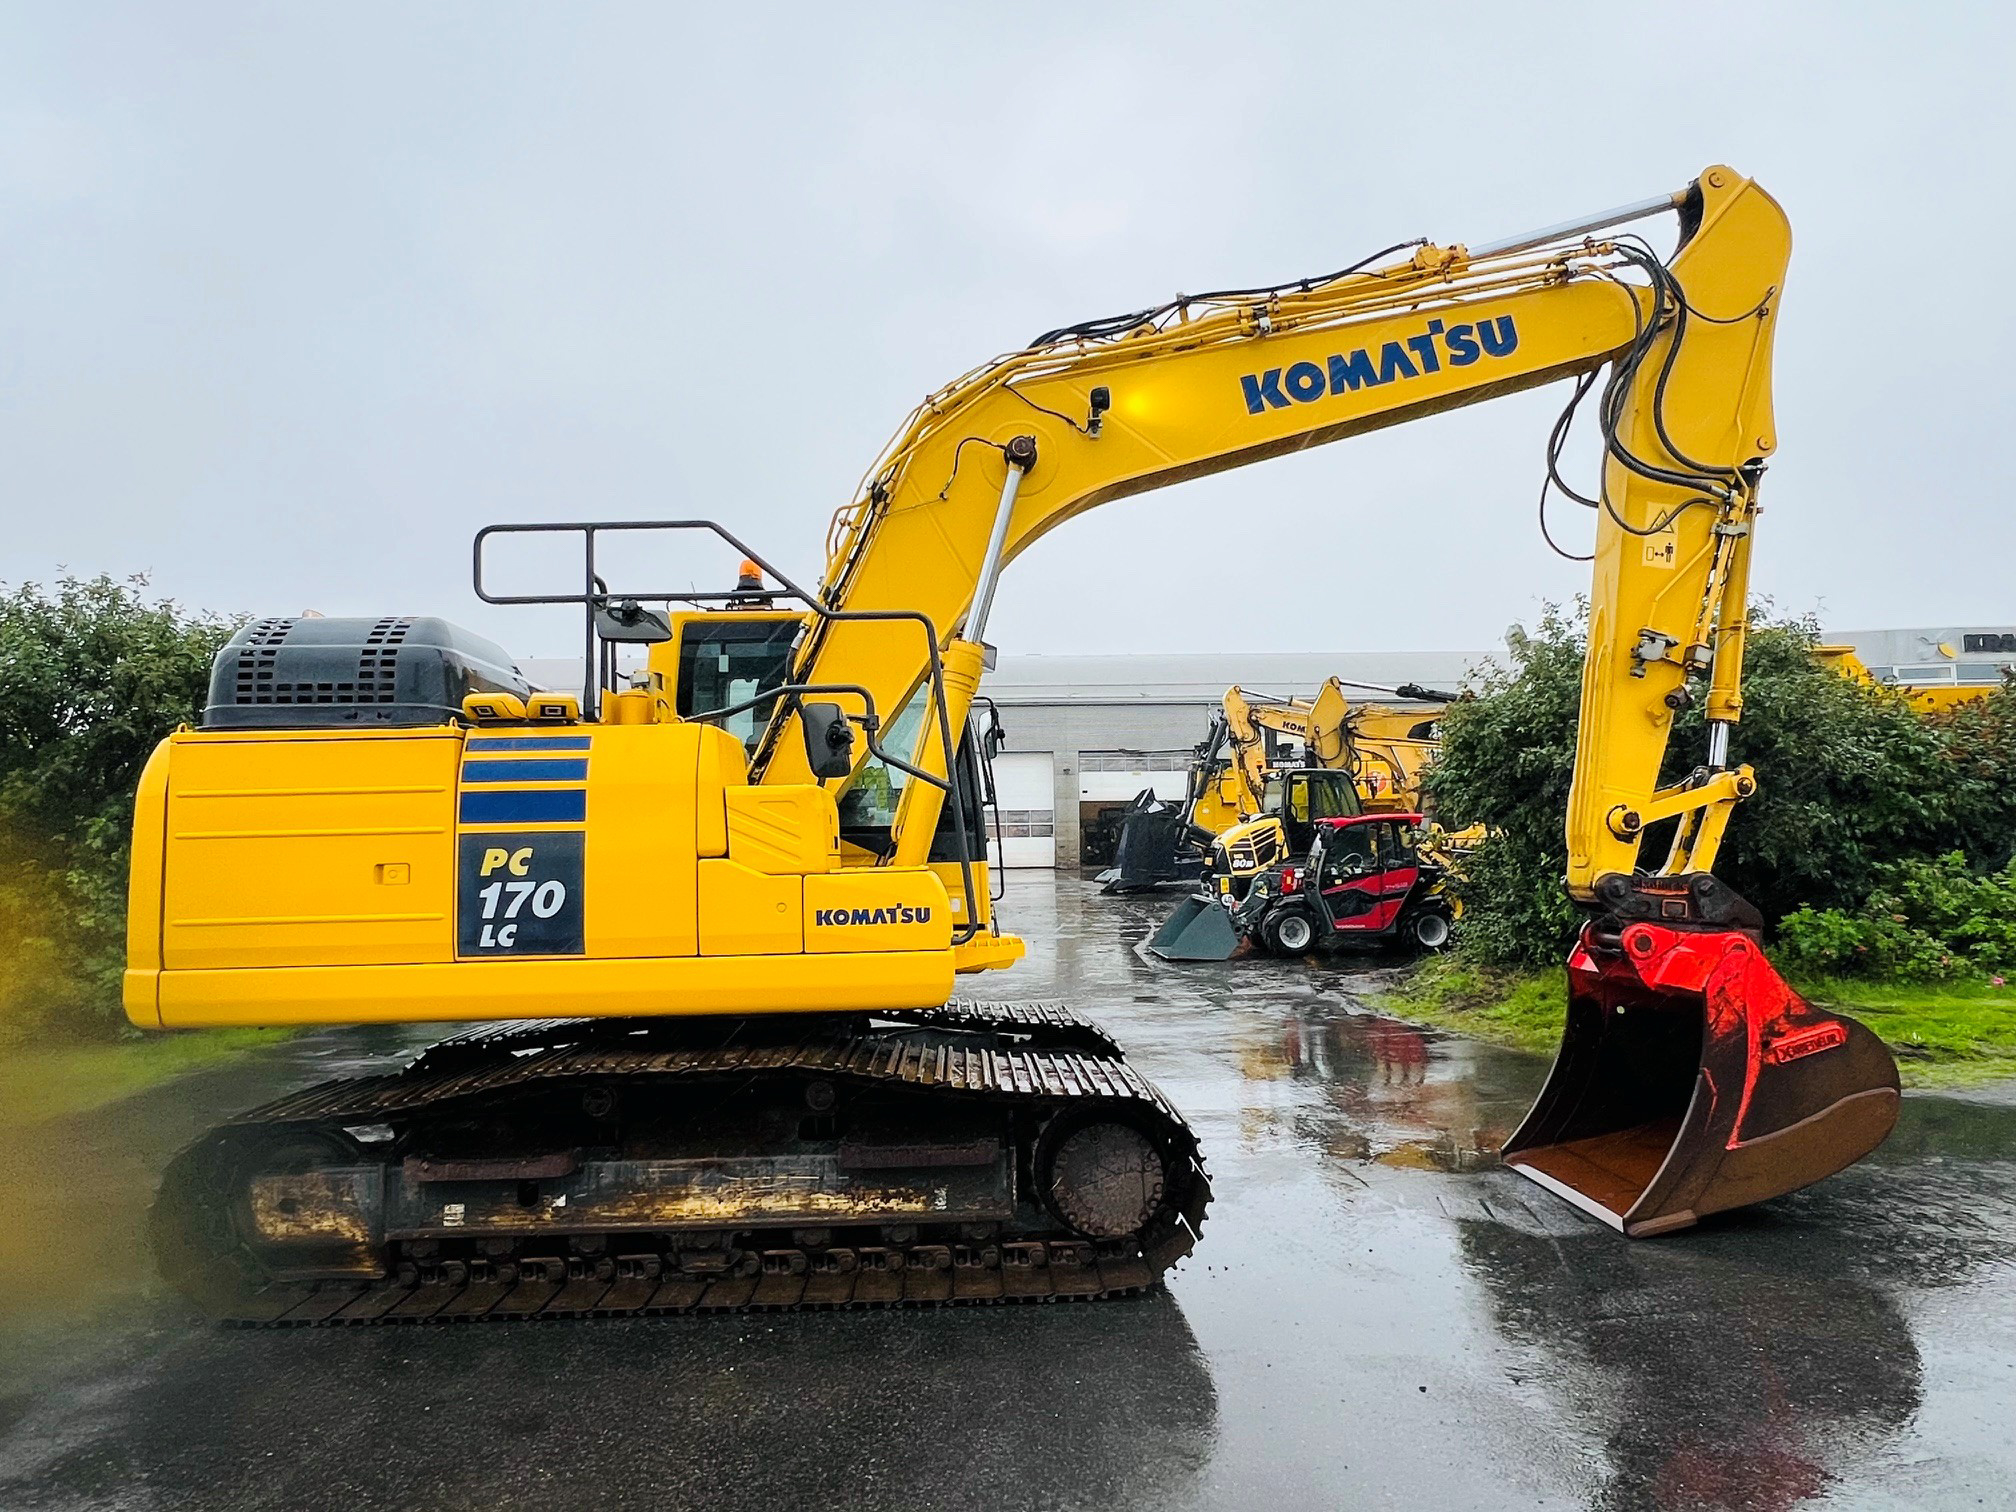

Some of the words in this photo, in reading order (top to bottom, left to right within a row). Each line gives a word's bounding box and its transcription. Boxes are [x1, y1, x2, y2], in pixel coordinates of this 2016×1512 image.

[1240, 315, 1519, 415] KOMATSU
[1282, 721, 1305, 732] KOM
[480, 847, 533, 876] PC
[479, 880, 566, 919] 170
[816, 903, 930, 926] KOMATSU
[479, 924, 518, 947] LC
